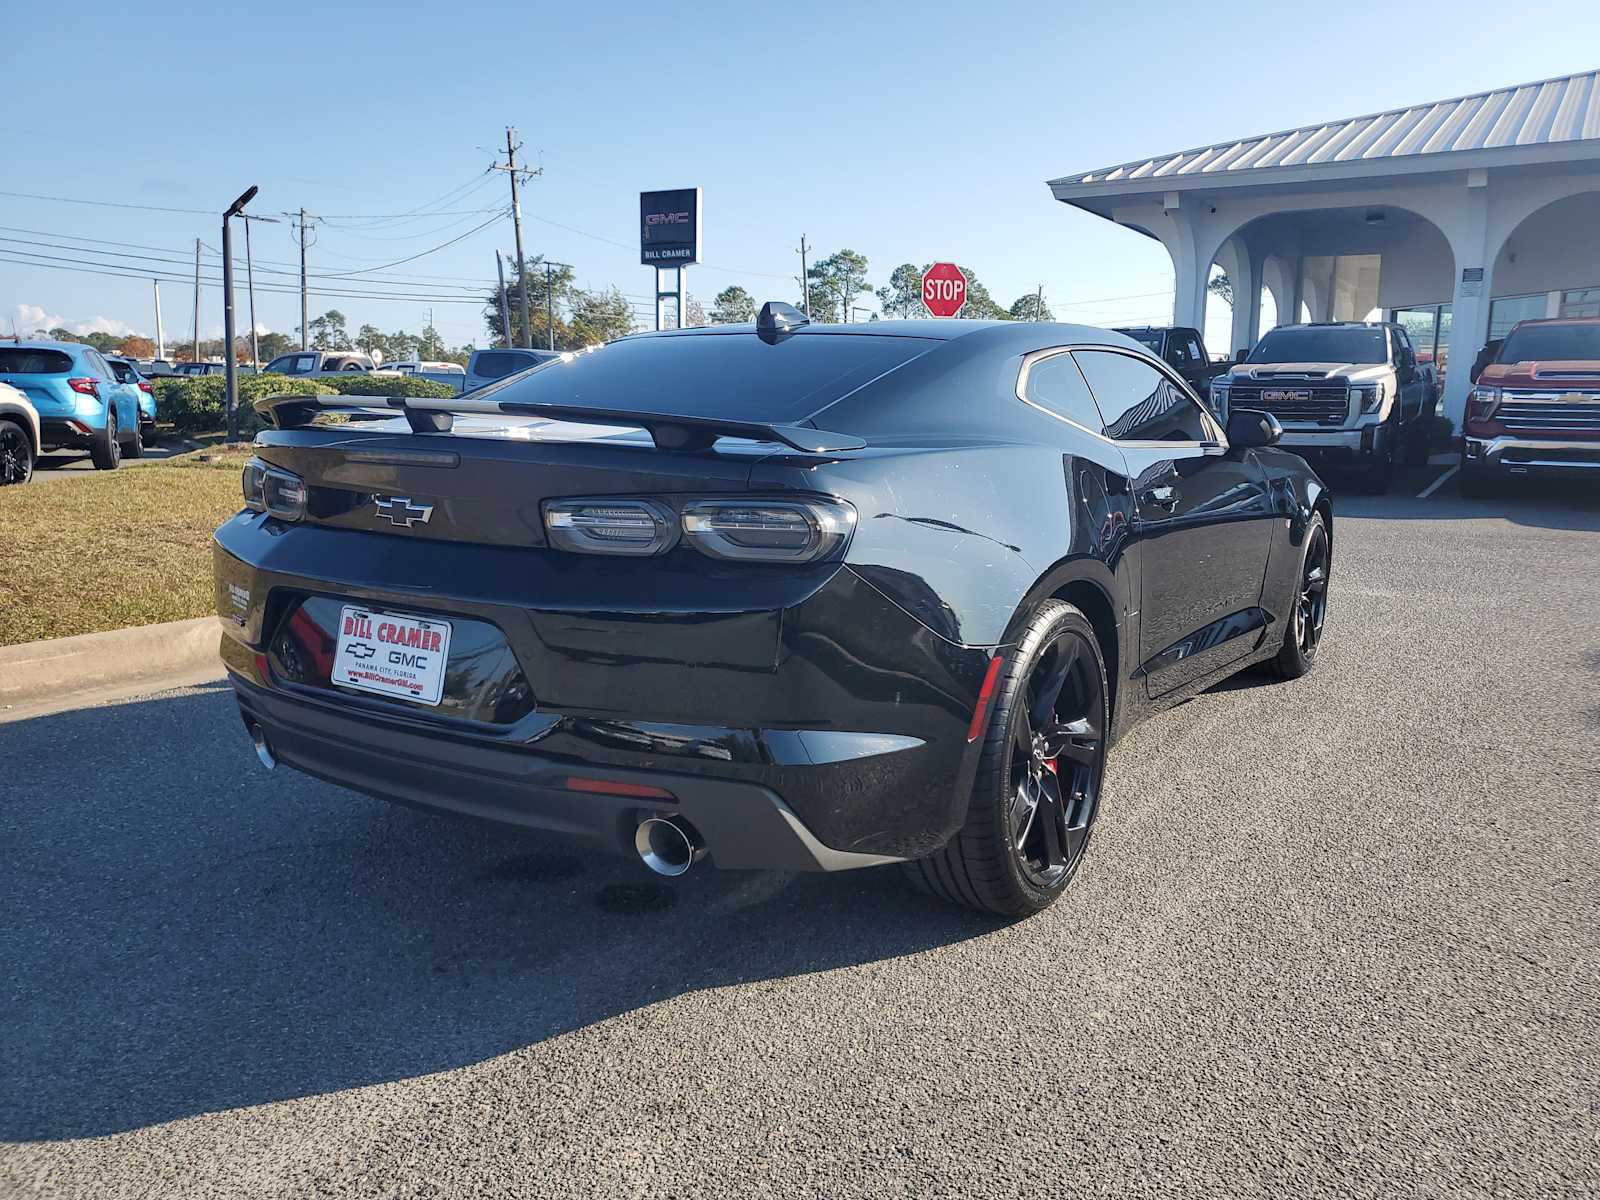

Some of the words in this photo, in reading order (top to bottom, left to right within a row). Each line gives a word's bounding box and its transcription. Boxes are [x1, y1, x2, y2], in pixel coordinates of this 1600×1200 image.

[646, 212, 689, 225] GMC
[645, 250, 660, 259] BILL
[661, 248, 691, 258] CRAMER
[925, 279, 964, 301] STOP
[1263, 391, 1309, 400] GMC
[343, 616, 373, 640] BILL
[377, 622, 442, 653] CRAMER
[388, 650, 428, 670] GMC
[355, 661, 378, 672] PANAMA
[393, 668, 416, 680] FLORIDA
